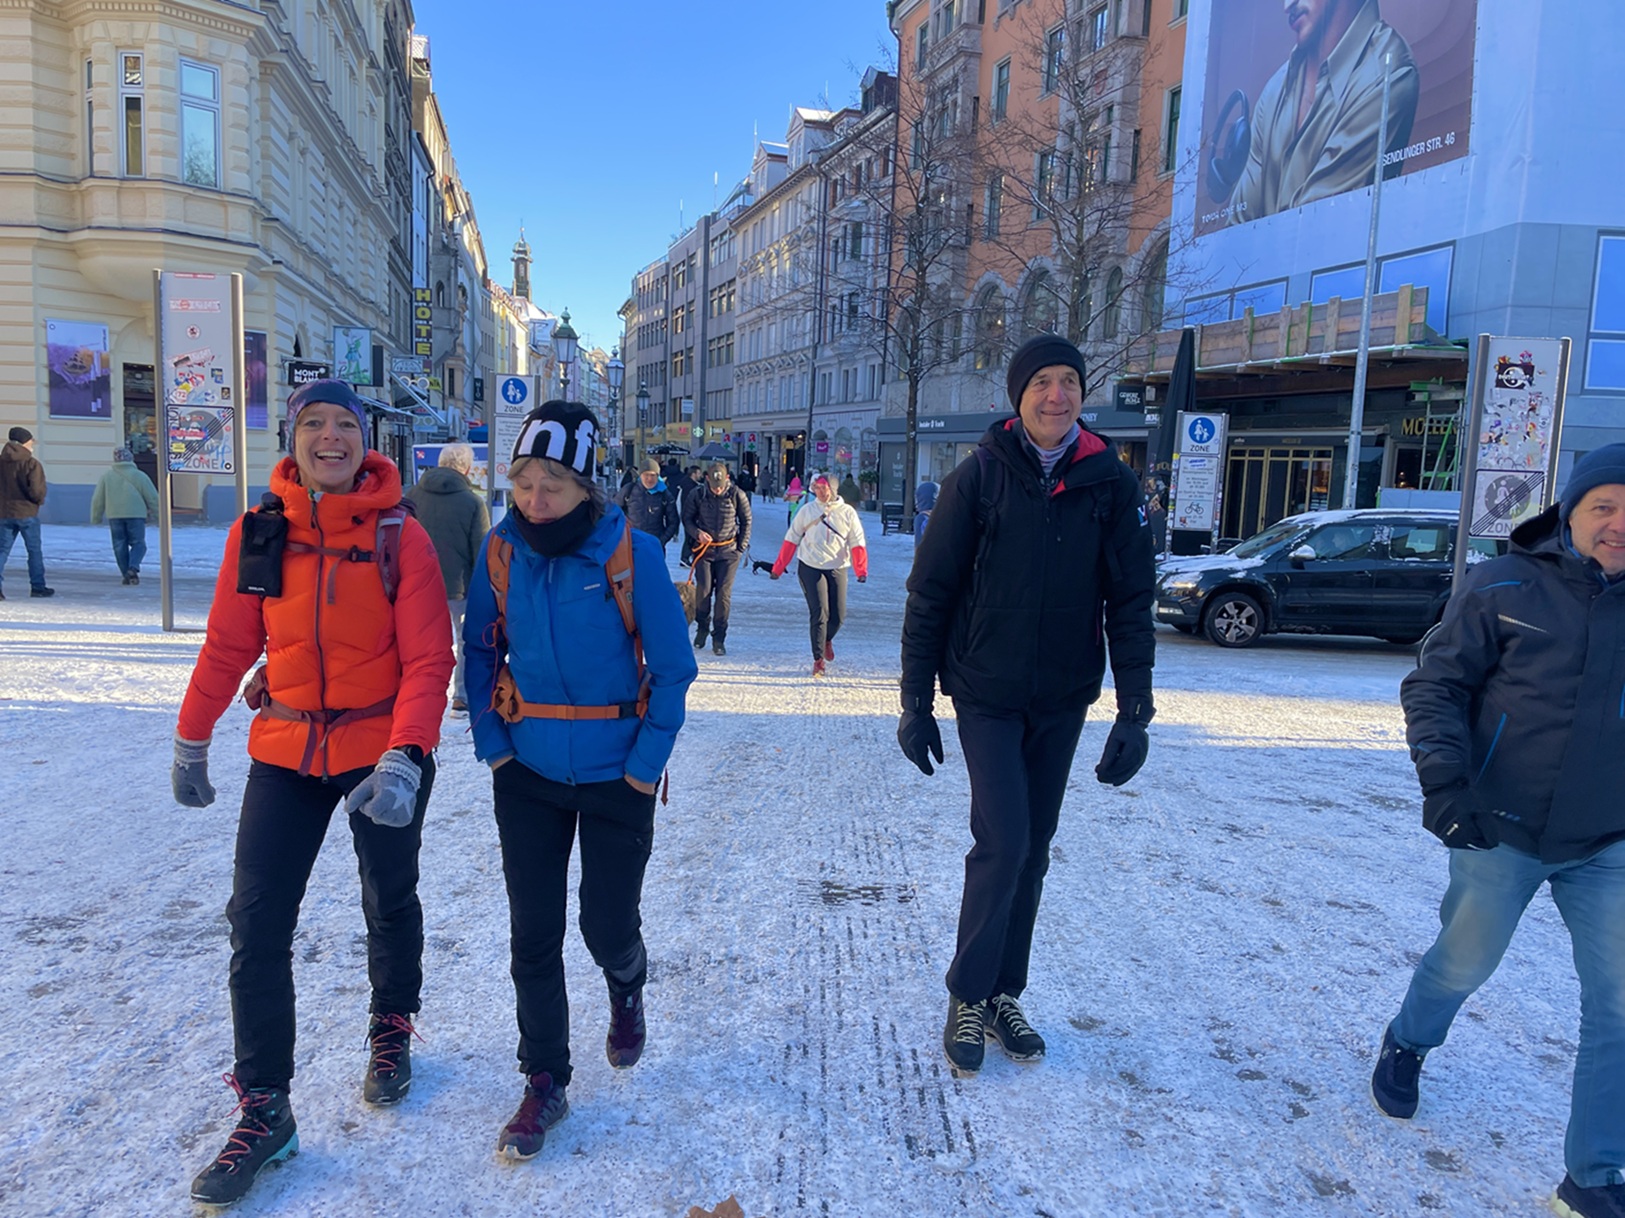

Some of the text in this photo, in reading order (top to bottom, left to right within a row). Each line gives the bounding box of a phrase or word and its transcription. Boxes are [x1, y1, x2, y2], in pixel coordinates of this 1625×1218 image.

[1382, 131, 1456, 166] SENDLINGER STR. 46
[294, 369, 319, 377] MONT
[504, 405, 524, 413] ZONE
[186, 457, 219, 470] ZONE
[1487, 522, 1517, 534] ZON
